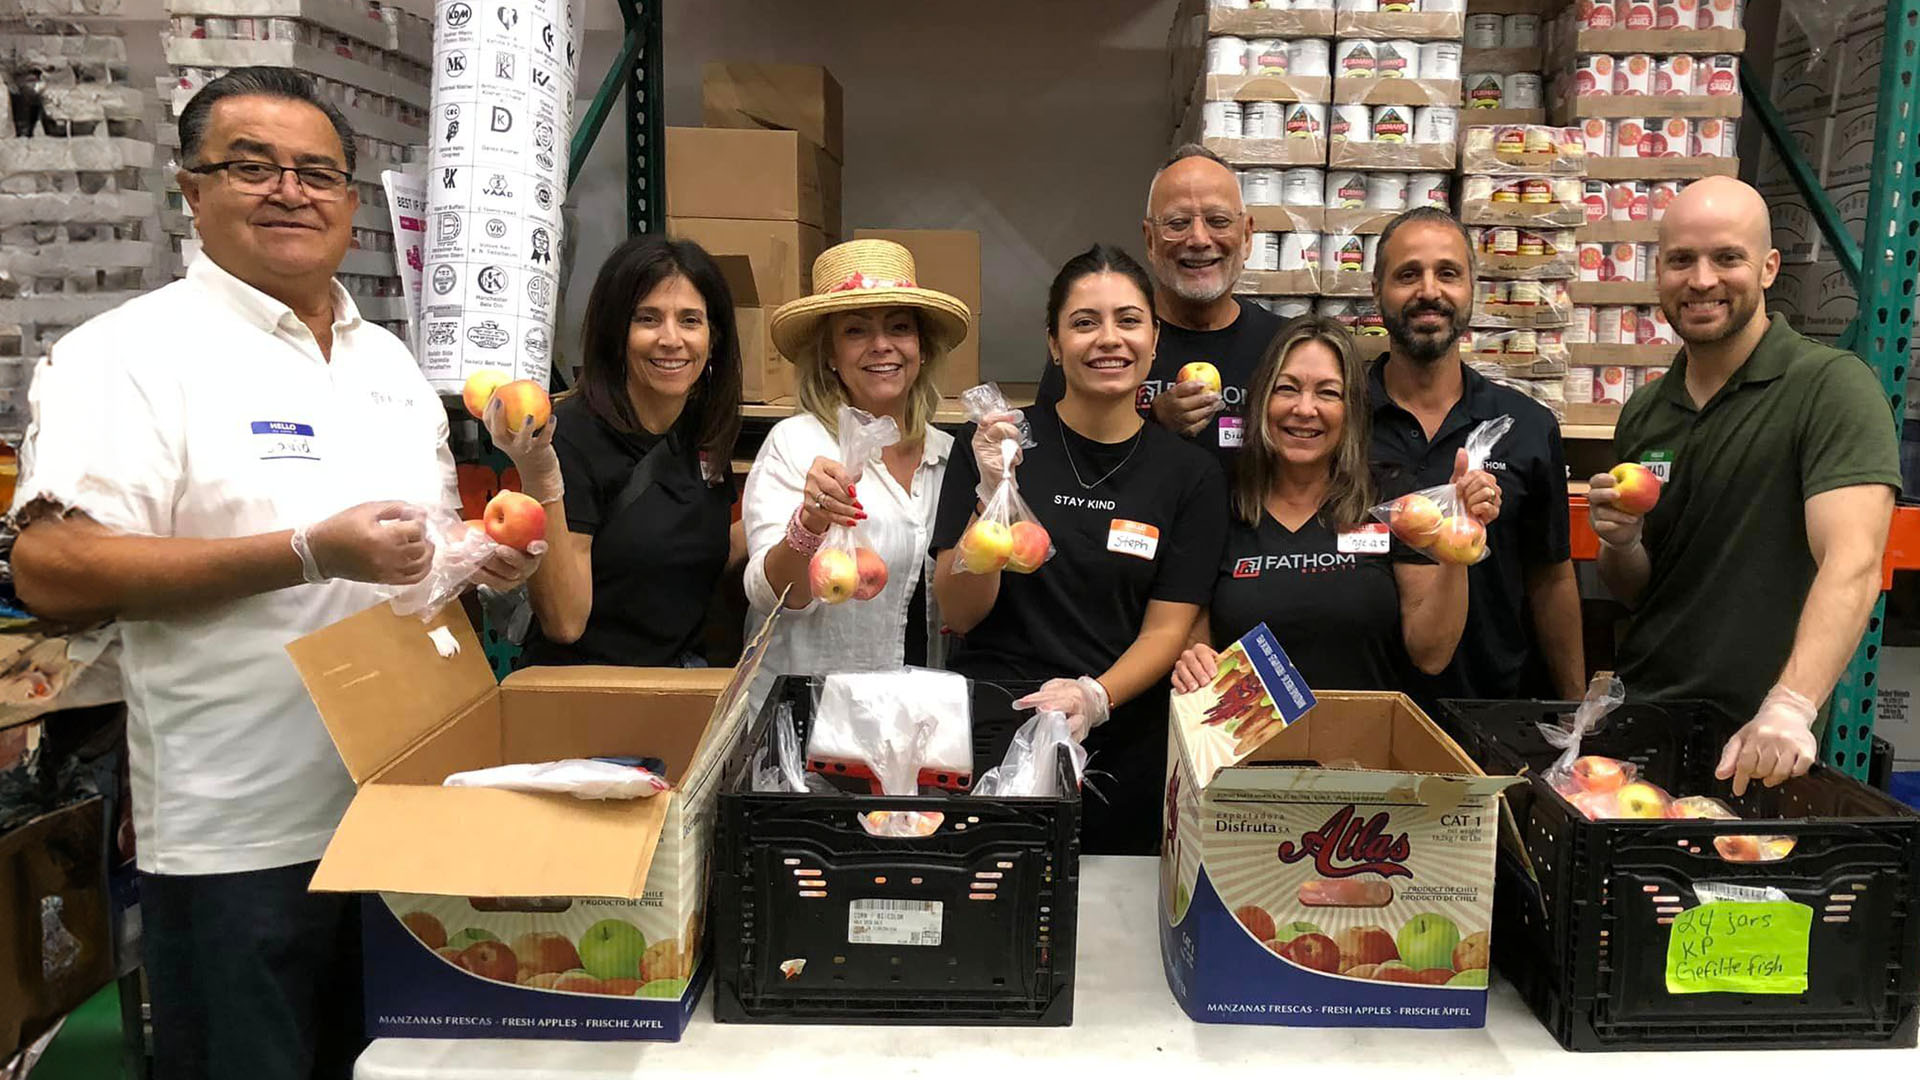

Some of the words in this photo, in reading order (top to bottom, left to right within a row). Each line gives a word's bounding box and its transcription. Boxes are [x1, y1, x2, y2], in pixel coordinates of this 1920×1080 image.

[447, 55, 465, 72] MK
[482, 188, 514, 198] VAAD
[489, 224, 503, 233] VK
[270, 422, 297, 431] HELLO
[1053, 494, 1086, 508] STAY
[1086, 498, 1117, 511] KIND
[1113, 535, 1149, 551] Steph
[1265, 553, 1356, 570] FATHOM
[1215, 811, 1286, 821] exportadora
[1440, 814, 1471, 827] CAT
[1475, 816, 1482, 827] 1
[1215, 819, 1277, 833] Disfruta
[1278, 804, 1414, 879] Atlas
[580, 899, 626, 907] PRODUCTO
[639, 900, 664, 908] CHILE
[1677, 908, 1714, 936] 24
[1725, 911, 1772, 936] jars
[1675, 956, 1742, 981] Gefilte
[1747, 953, 1783, 977] fish
[1207, 1003, 1267, 1014] MANZANAS
[1268, 1004, 1313, 1014] FRESCAS
[1321, 1005, 1353, 1015] FRESH
[1354, 1006, 1392, 1016] APPLES
[1399, 1007, 1441, 1016] FRISCHE
[1441, 1005, 1472, 1016] ÄPFEL
[378, 1015, 443, 1025] MANZANAS
[445, 1016, 493, 1026] FRESCAS
[501, 1017, 536, 1027] FRESH
[537, 1018, 578, 1028] APPLES
[585, 1019, 630, 1028] FRISCHE
[631, 1017, 665, 1029] ÄPFEL
